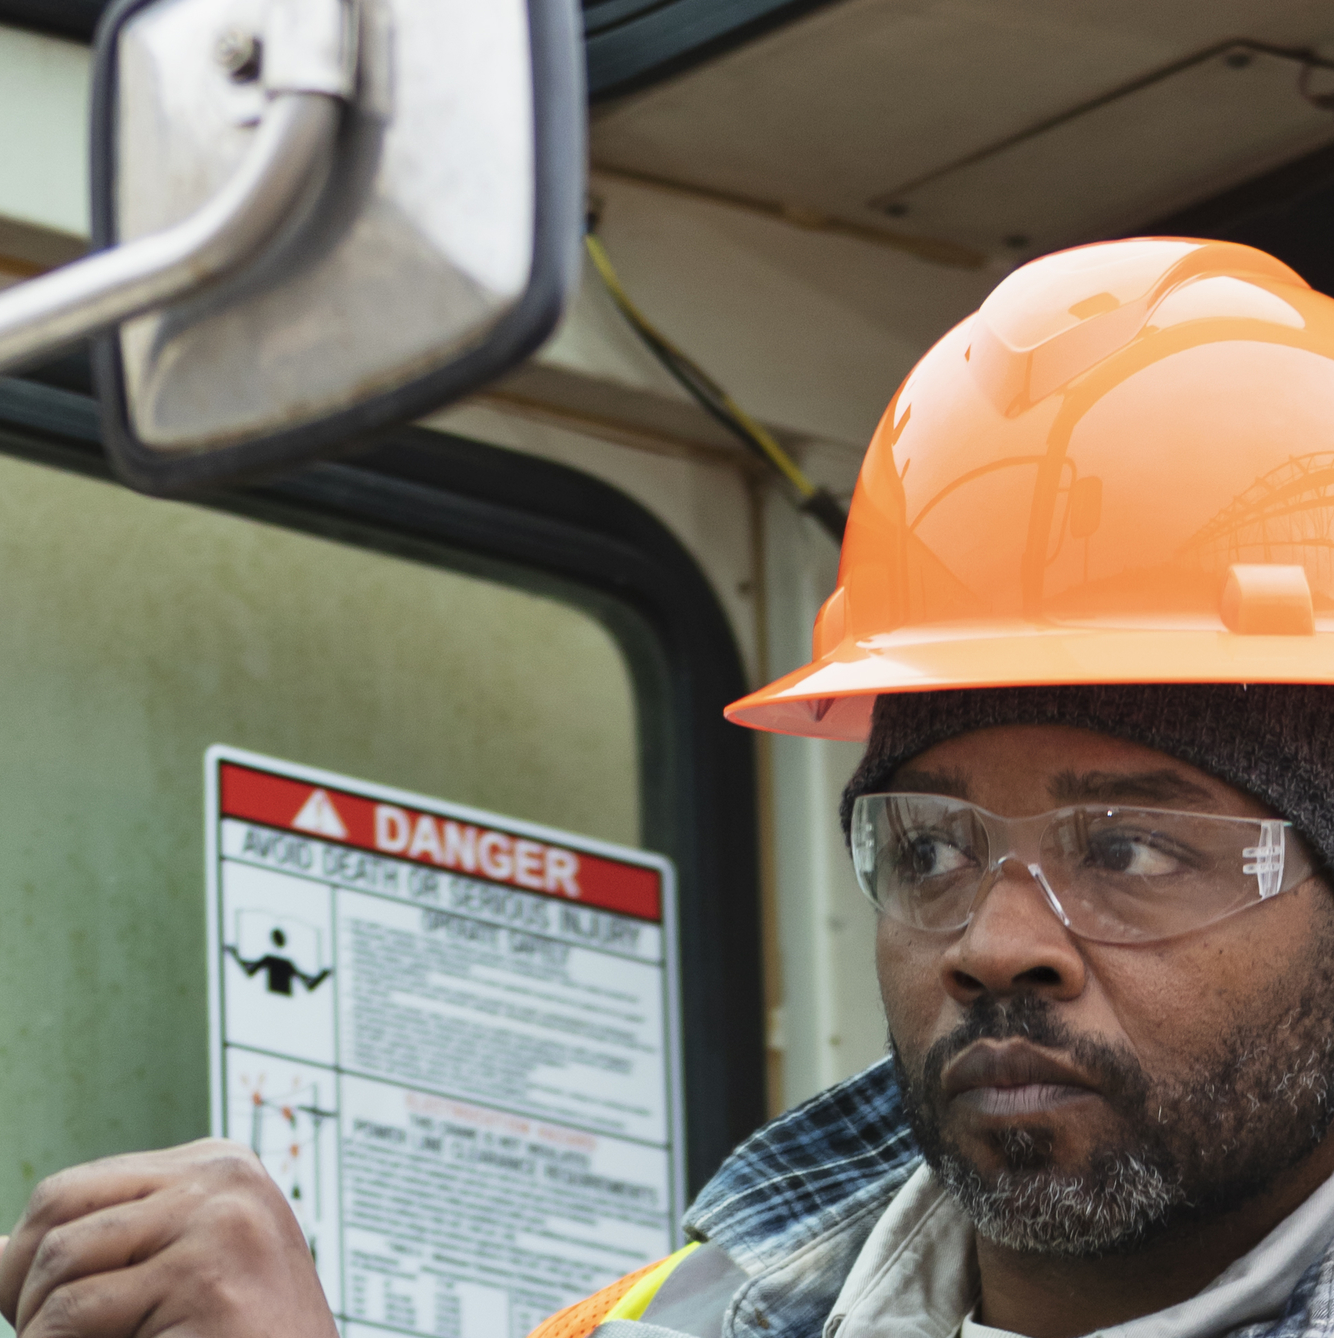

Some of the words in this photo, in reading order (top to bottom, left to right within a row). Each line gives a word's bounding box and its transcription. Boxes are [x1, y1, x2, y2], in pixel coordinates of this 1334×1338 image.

[243, 828, 313, 870] AVOID
[322, 844, 399, 887] DEATH
[374, 804, 580, 897] DANGER
